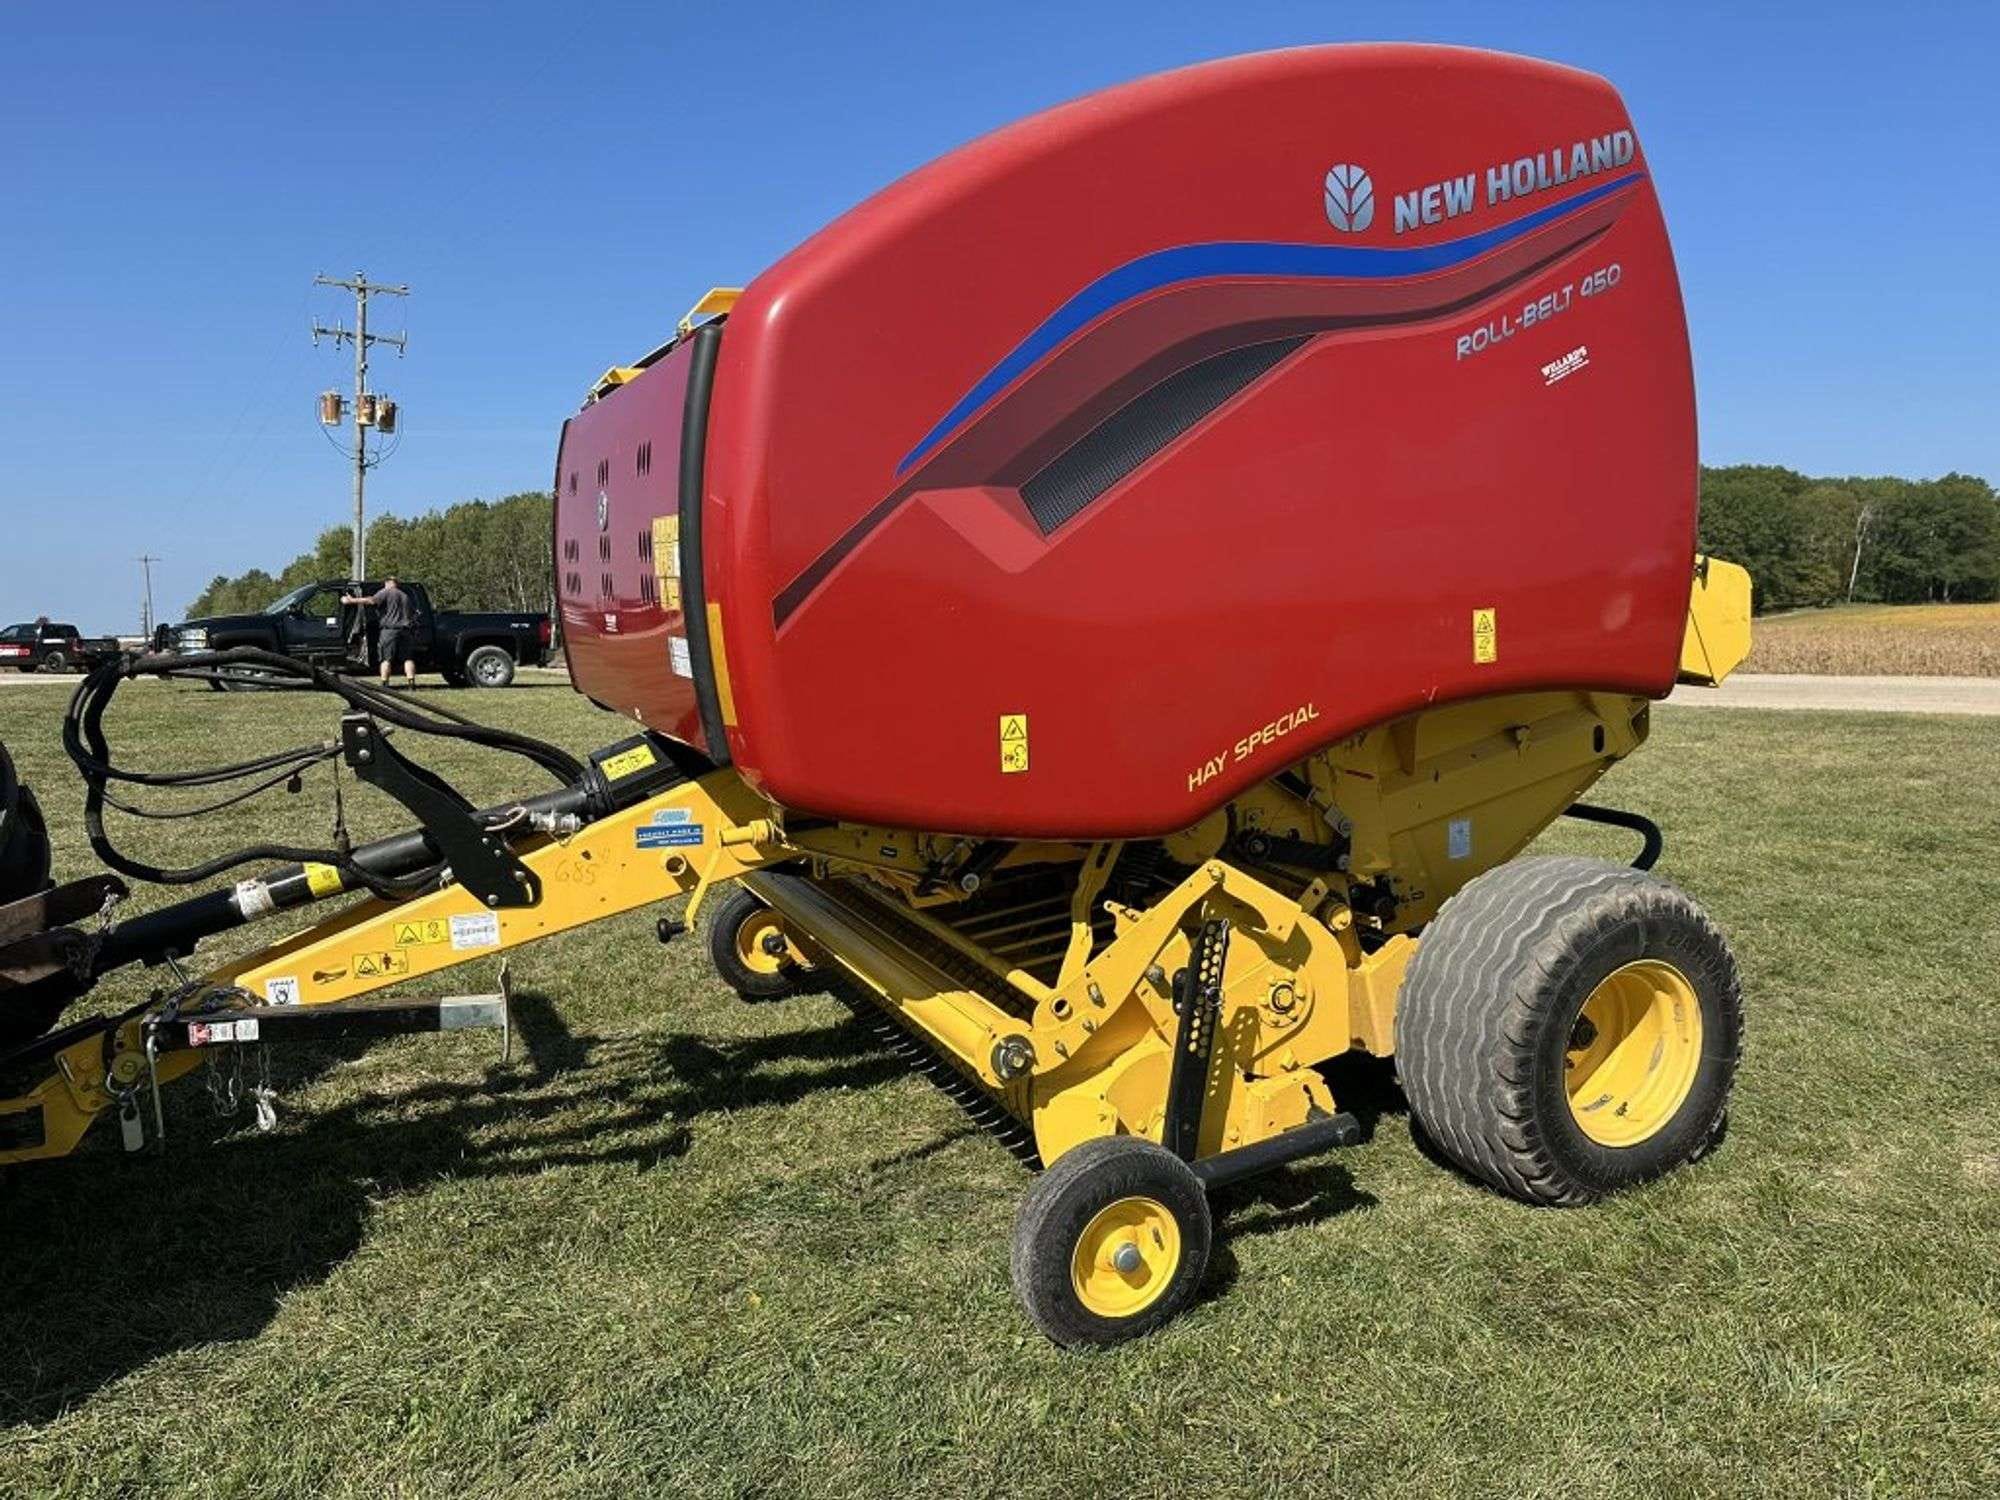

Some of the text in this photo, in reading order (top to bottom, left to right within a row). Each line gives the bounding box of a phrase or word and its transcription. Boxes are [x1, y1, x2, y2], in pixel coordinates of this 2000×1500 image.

[1393, 129, 1635, 234] NEW HOLLAND
[1456, 263, 1621, 361] ROLL-BELT 450
[1188, 702, 1320, 792] HAY SPECIAL
